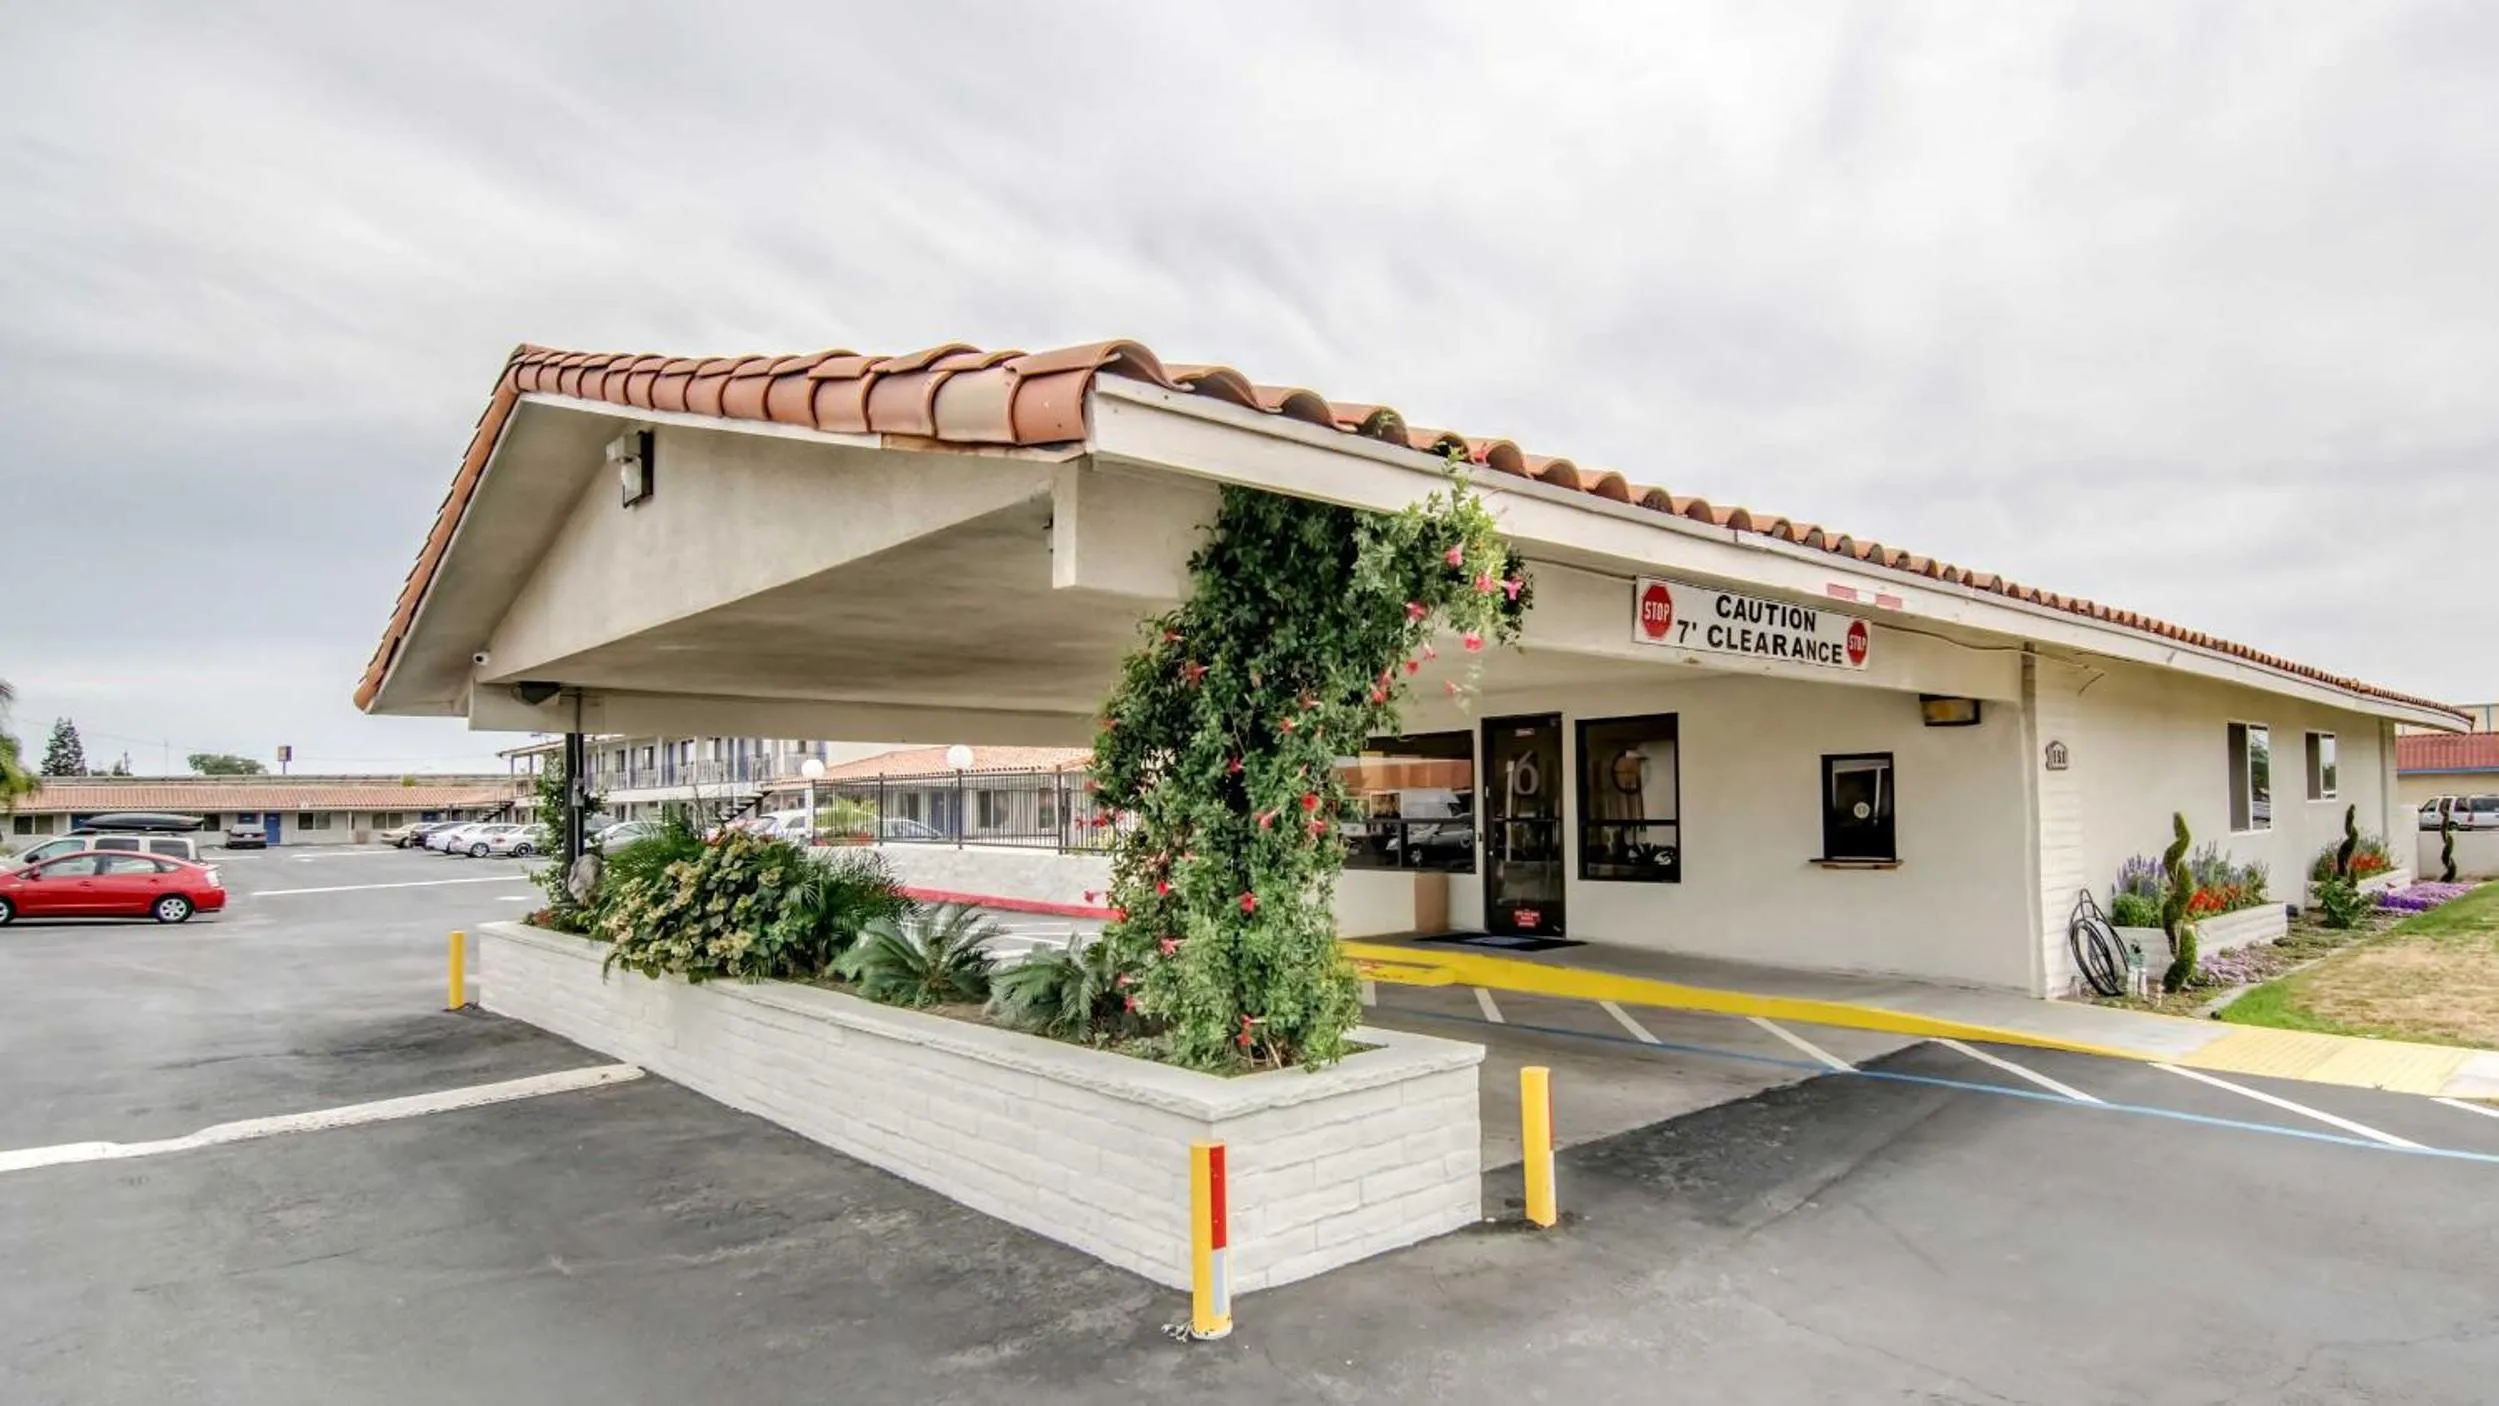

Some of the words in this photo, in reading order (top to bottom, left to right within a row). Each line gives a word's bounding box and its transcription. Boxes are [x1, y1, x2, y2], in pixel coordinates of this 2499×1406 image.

[1644, 600, 1670, 622] STOP
[1716, 595, 1816, 631] CAUTION
[1677, 619, 1697, 643] 7'
[1707, 625, 1842, 664] CLEARANCE
[1513, 749, 1539, 795] 6
